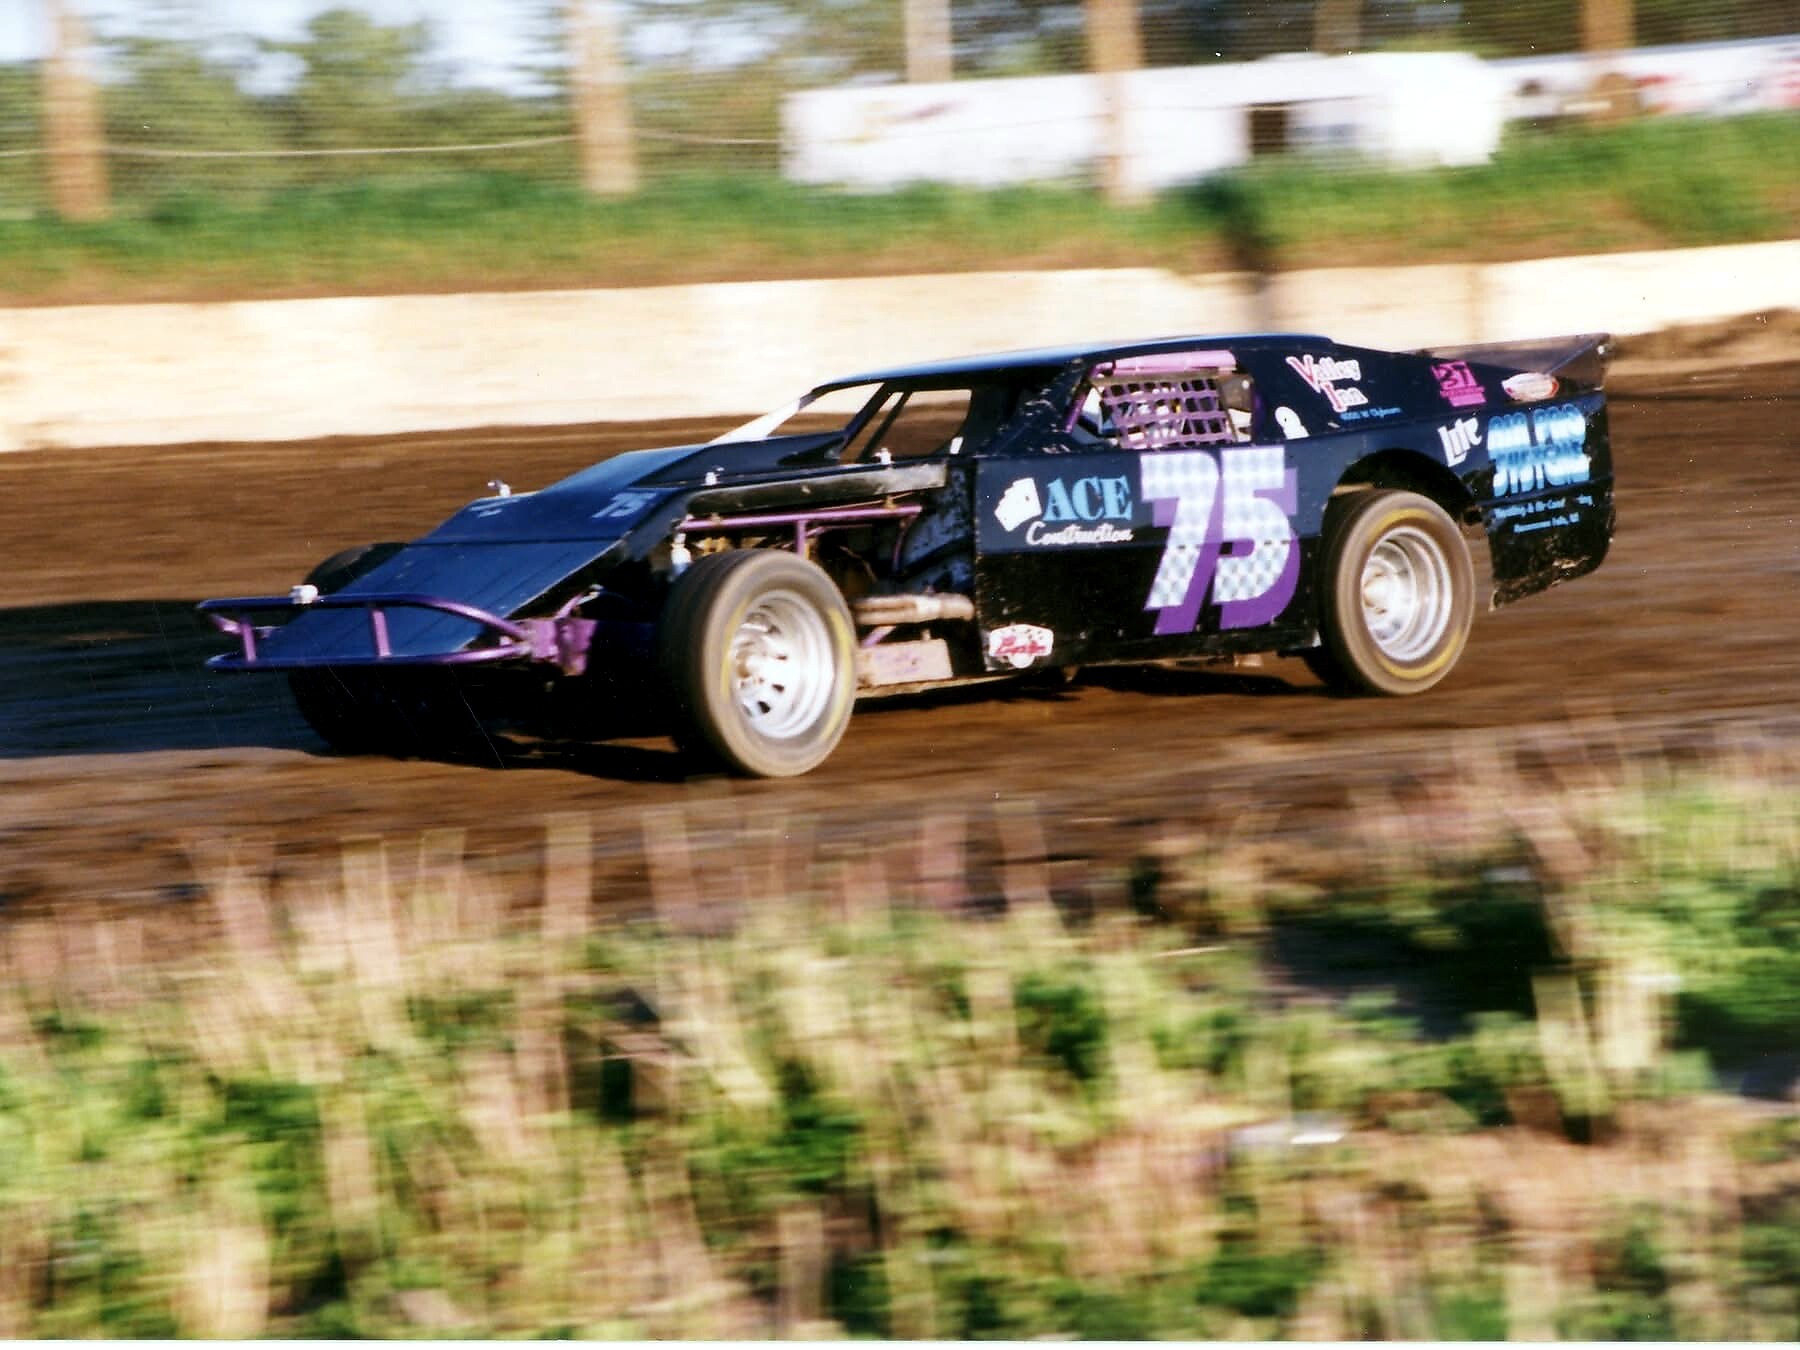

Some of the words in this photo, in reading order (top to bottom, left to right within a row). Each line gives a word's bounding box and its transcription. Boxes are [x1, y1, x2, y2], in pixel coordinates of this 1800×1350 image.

[1437, 416, 1483, 467] Lite
[1042, 475, 1133, 521] ACE
[1025, 520, 1134, 546] Construction
[1140, 445, 1301, 635] 75
